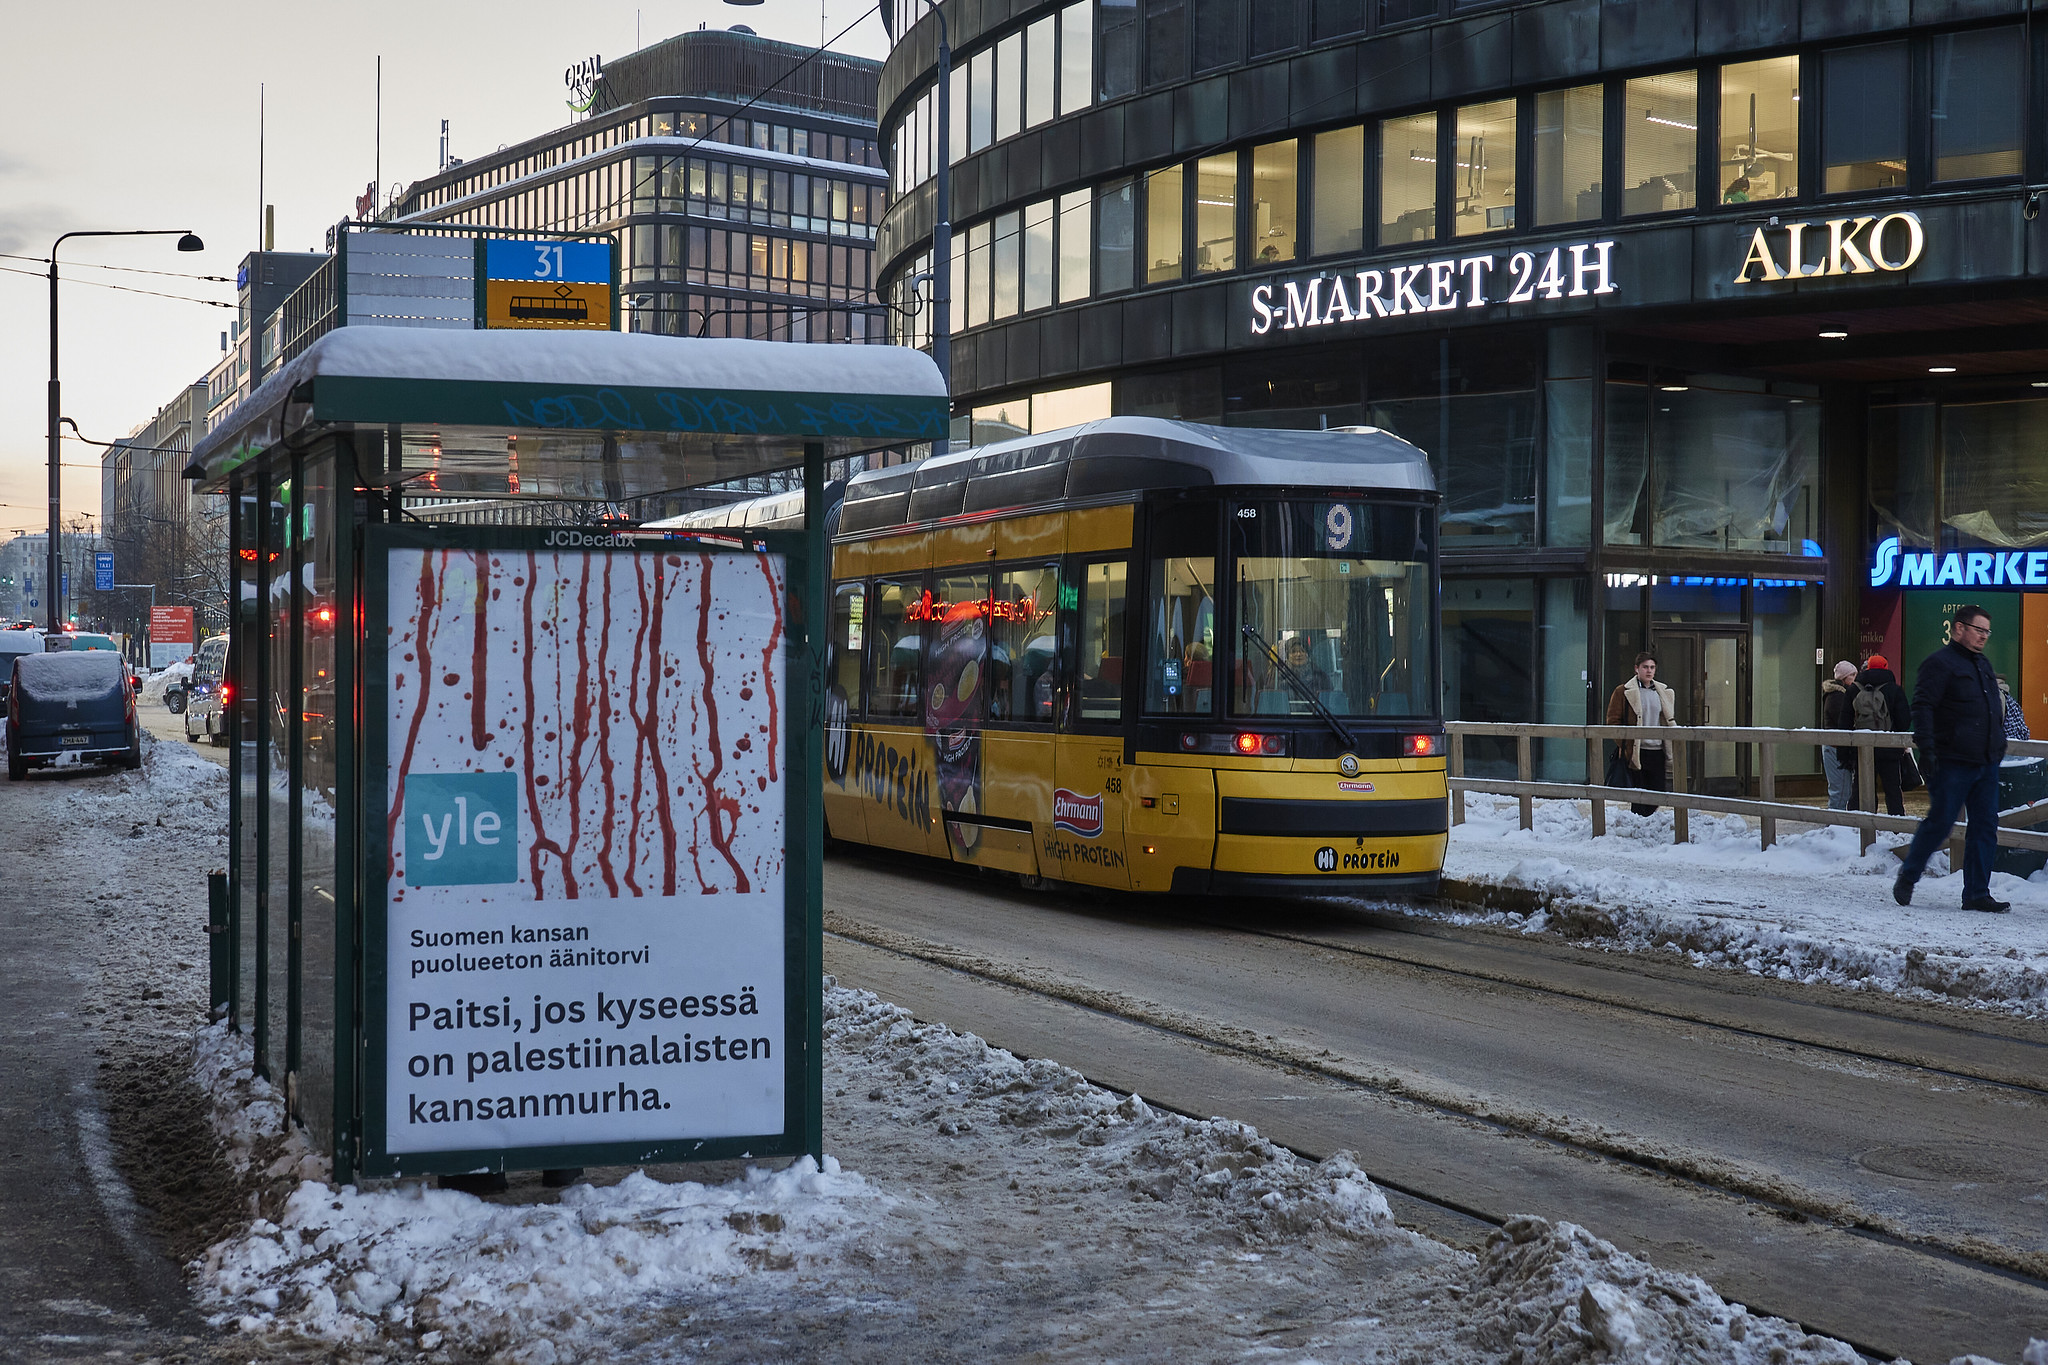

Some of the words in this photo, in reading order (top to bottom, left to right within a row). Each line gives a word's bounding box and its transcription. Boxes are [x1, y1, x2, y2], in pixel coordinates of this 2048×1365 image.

[564, 54, 603, 89] ORAL
[533, 245, 564, 278] 31
[1734, 211, 1924, 284] ALKO
[1251, 254, 1494, 334] S-MARKET
[1508, 241, 1616, 303] 24H
[1237, 508, 1257, 518] 458
[1327, 504, 1352, 550] 9
[544, 531, 636, 548] JCDecaux
[1860, 631, 1884, 643] inikka
[1105, 777, 1122, 794] 458
[1339, 781, 1372, 790] Ehrmann
[1055, 796, 1099, 821] Ehrmann
[423, 797, 502, 861] yle
[1043, 839, 1071, 862] HIGH
[1074, 843, 1124, 869] PROTEIN
[410, 929, 504, 948] Suomen
[511, 924, 589, 944] kansan
[410, 952, 543, 979] puolueeton
[549, 944, 650, 968] äänitorvi
[409, 995, 522, 1034] Paitsi,
[530, 994, 586, 1034] jos
[597, 985, 759, 1030] kyseessä
[407, 1053, 454, 1078] on
[467, 1032, 771, 1083] palestiinalaisten
[408, 1081, 671, 1125] kansanmurha.
